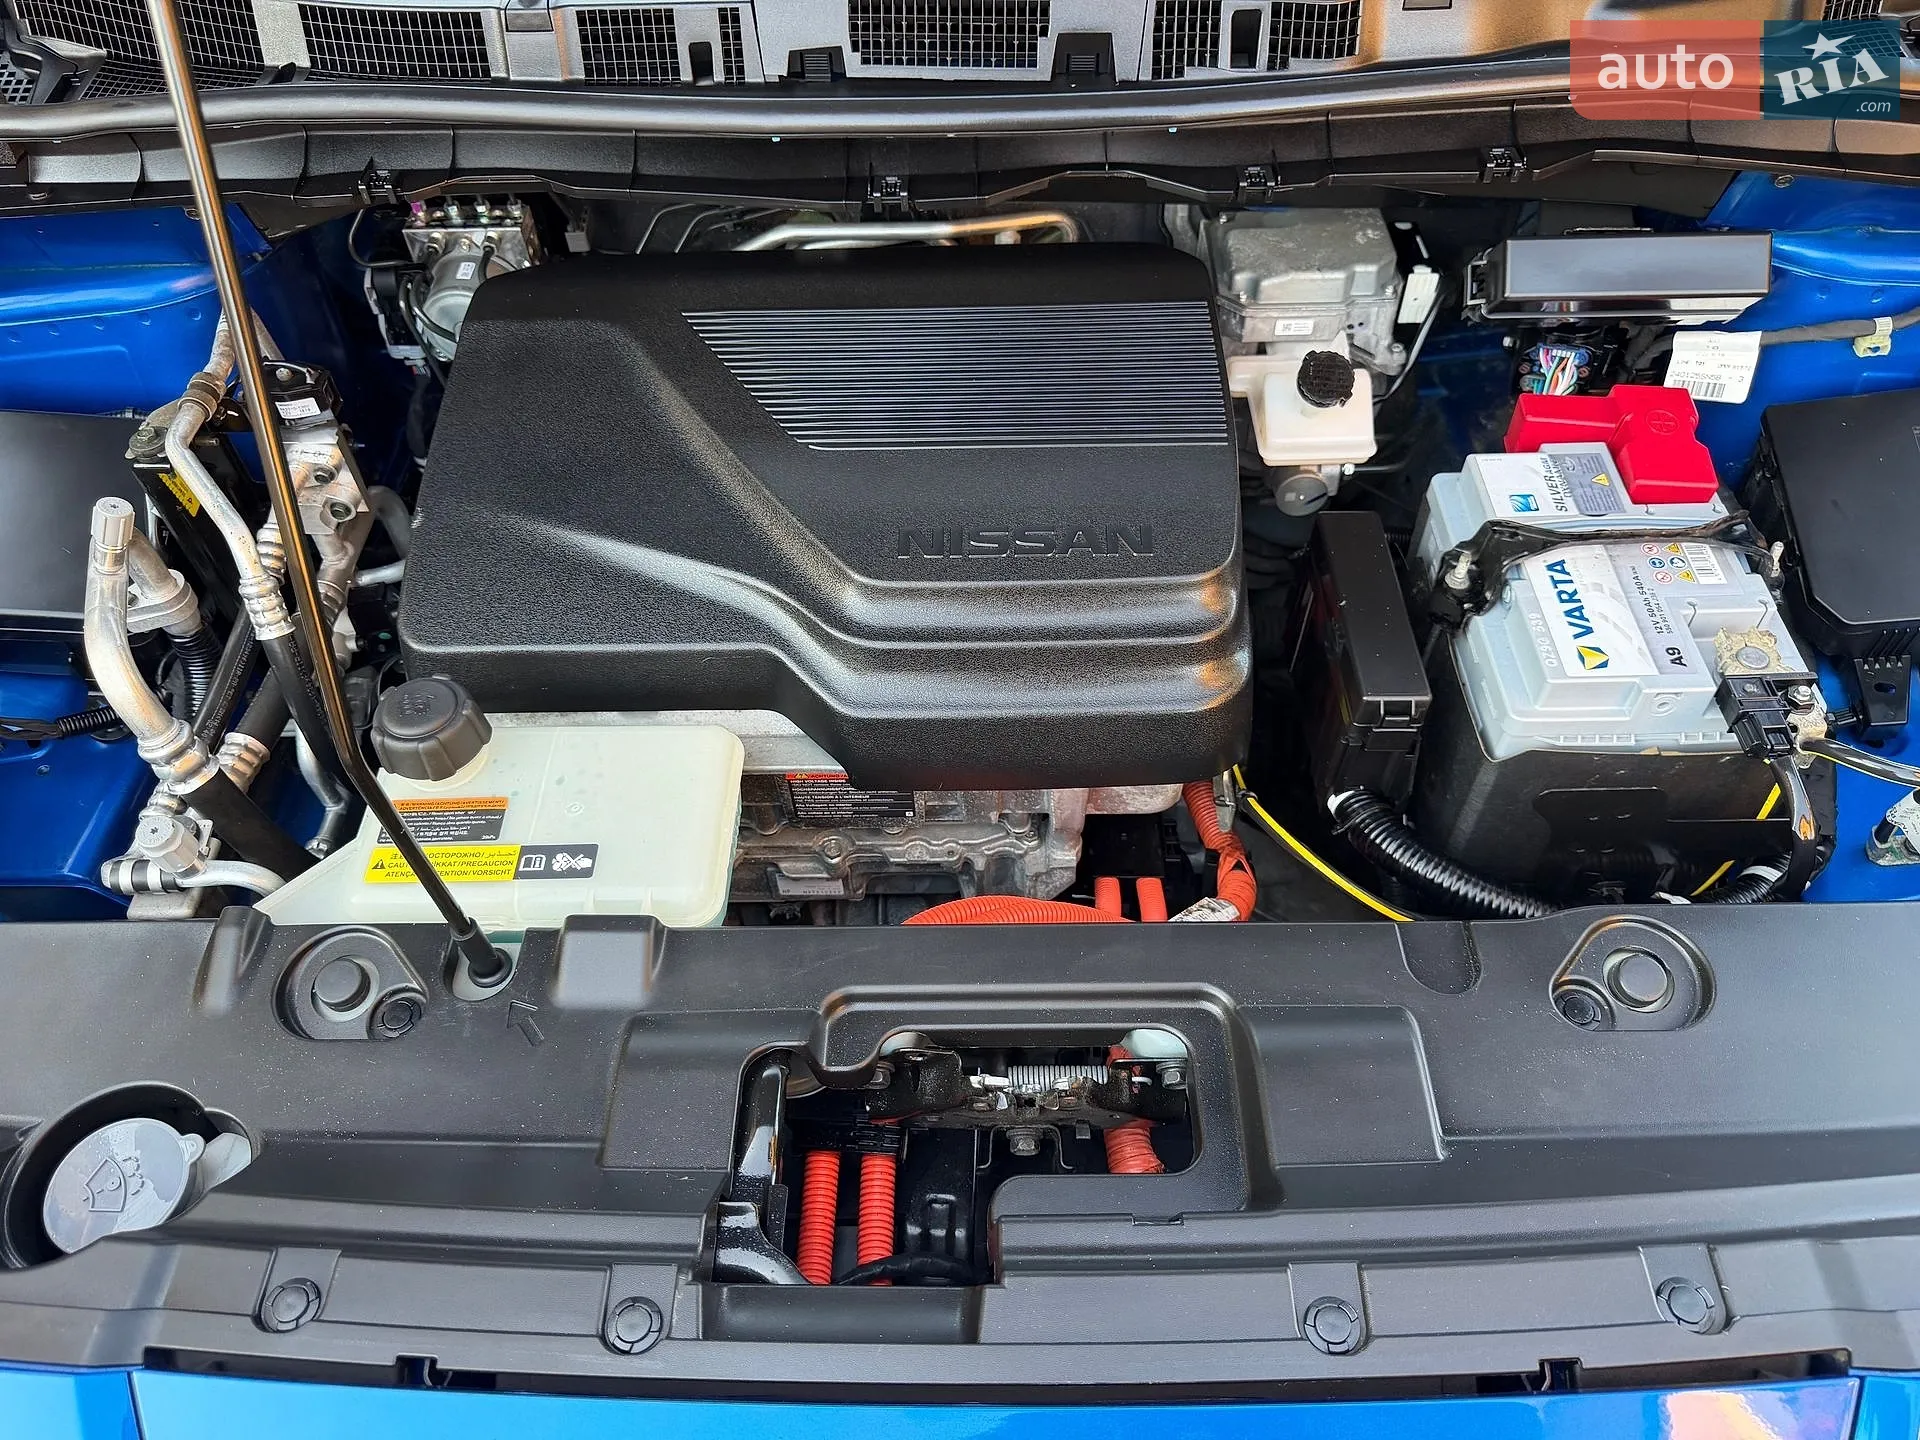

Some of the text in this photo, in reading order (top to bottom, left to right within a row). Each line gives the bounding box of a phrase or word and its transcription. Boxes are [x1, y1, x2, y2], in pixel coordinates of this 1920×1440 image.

[1544, 475, 1568, 512] SILVER
[898, 526, 1154, 558] NISSAN
[1548, 558, 1594, 640] VARTA
[1643, 597, 1658, 618] 50Ah
[1651, 619, 1665, 635] 12V
[1668, 645, 1688, 668] A9
